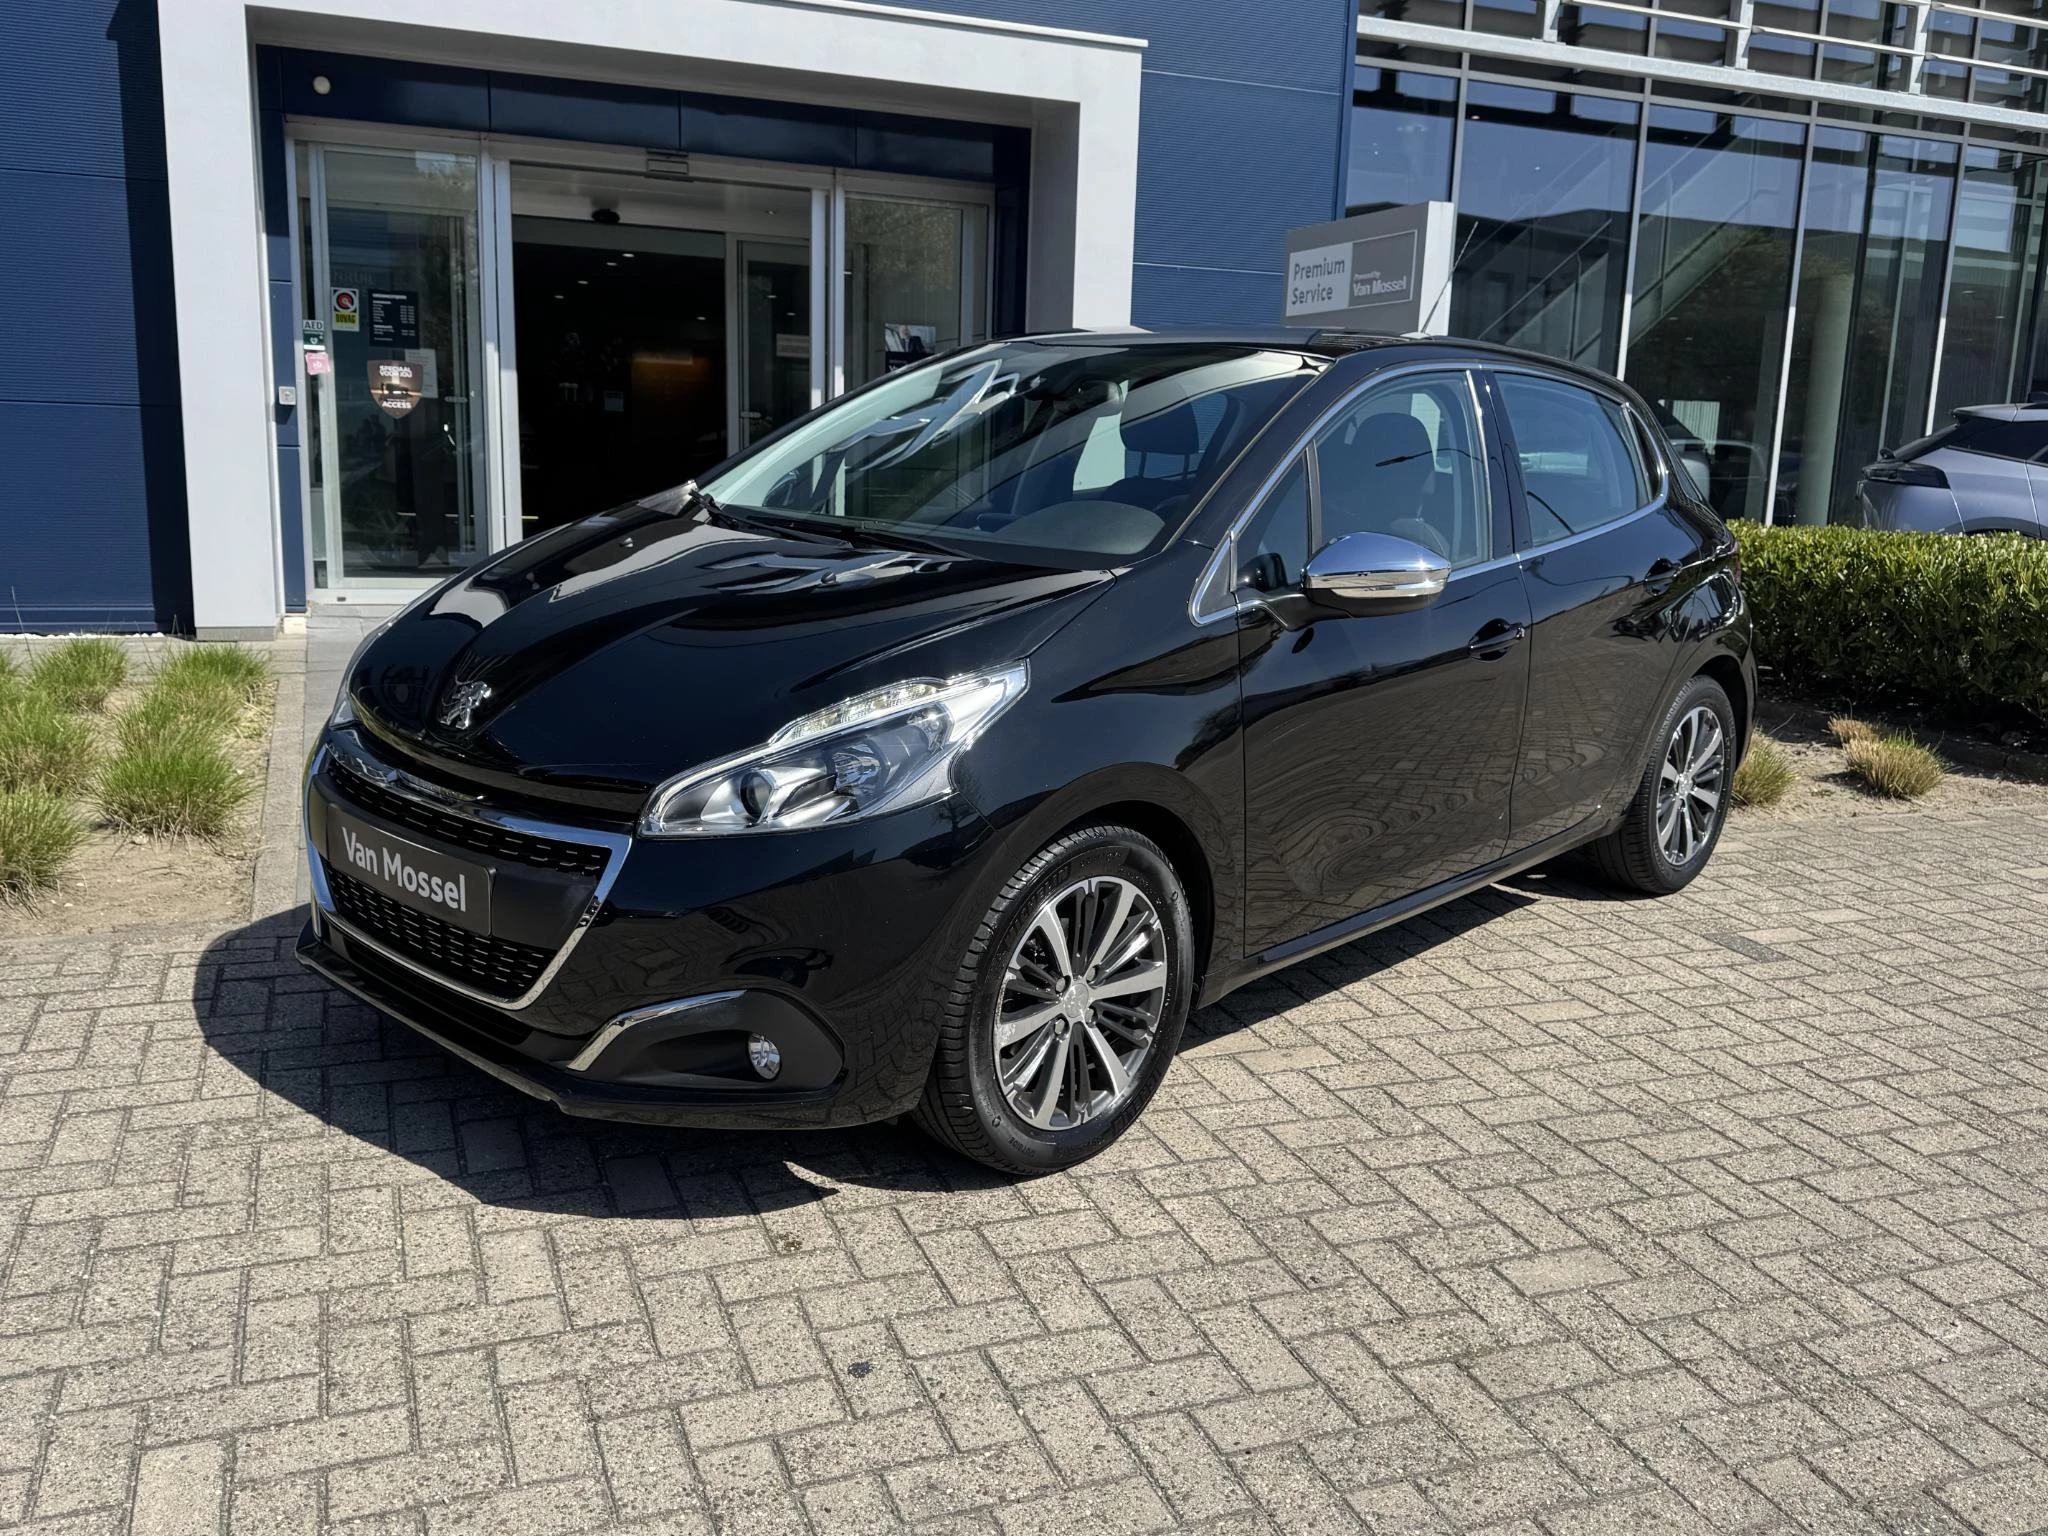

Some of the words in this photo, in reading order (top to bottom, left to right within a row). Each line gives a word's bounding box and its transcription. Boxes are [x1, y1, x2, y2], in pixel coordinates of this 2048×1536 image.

[1293, 257, 1345, 282] Premium
[1291, 283, 1334, 305] Service
[1353, 282, 1370, 296] Van
[1372, 275, 1407, 295] Mossel
[304, 321, 323, 330] AED
[335, 313, 356, 324] BOVAG
[341, 826, 378, 876] Van
[382, 847, 466, 912] Mossel
